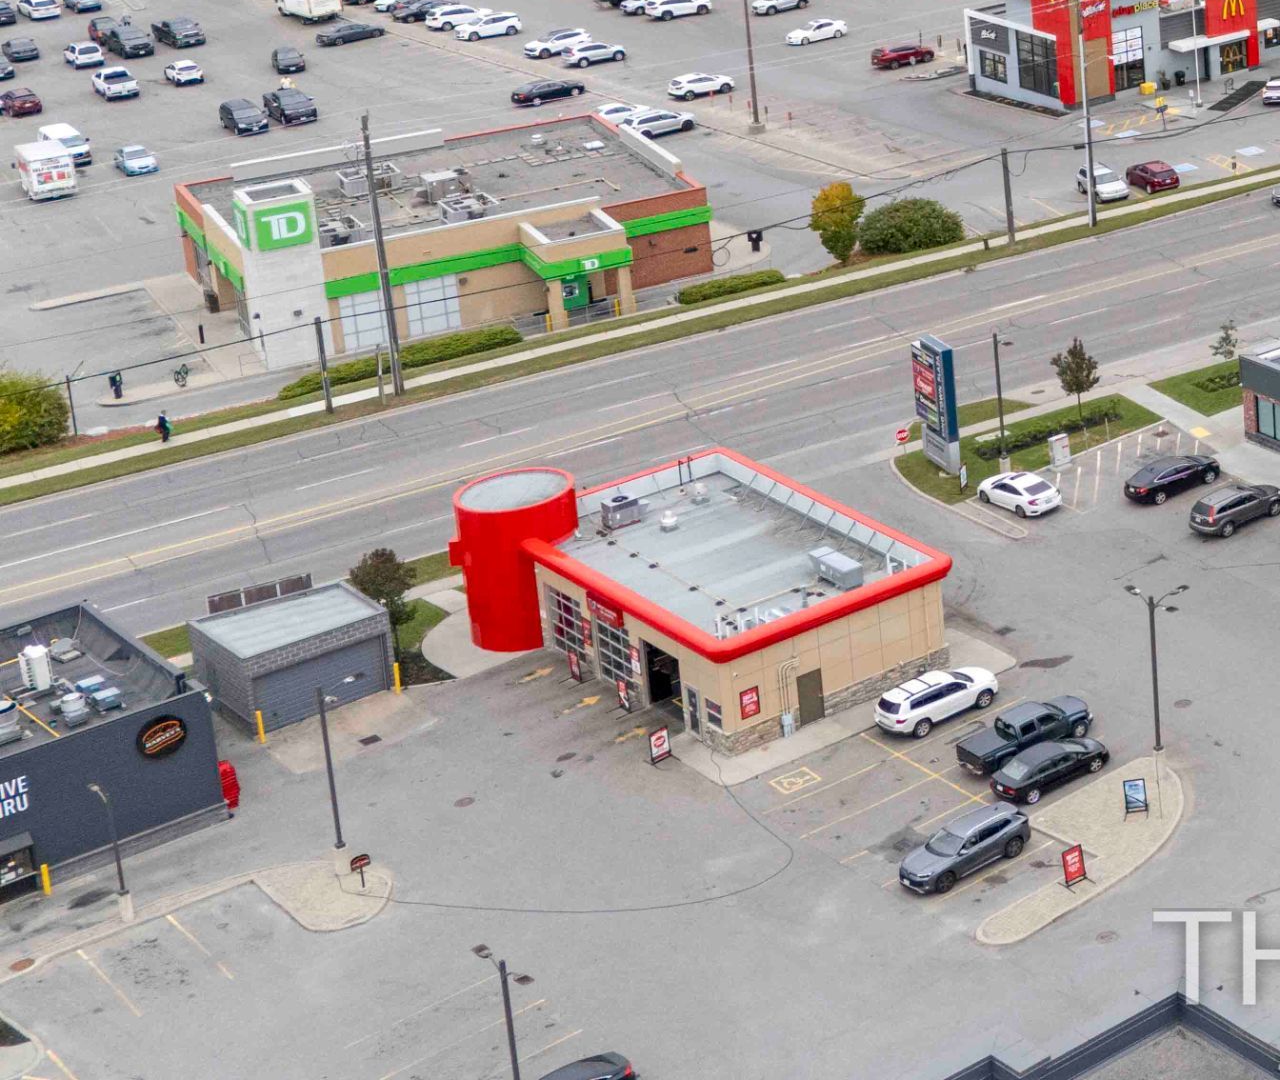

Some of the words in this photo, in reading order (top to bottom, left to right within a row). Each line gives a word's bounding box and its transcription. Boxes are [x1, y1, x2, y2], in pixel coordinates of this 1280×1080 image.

[261, 211, 306, 241] TD
[581, 258, 600, 270] TD
[896, 431, 908, 440] STOP
